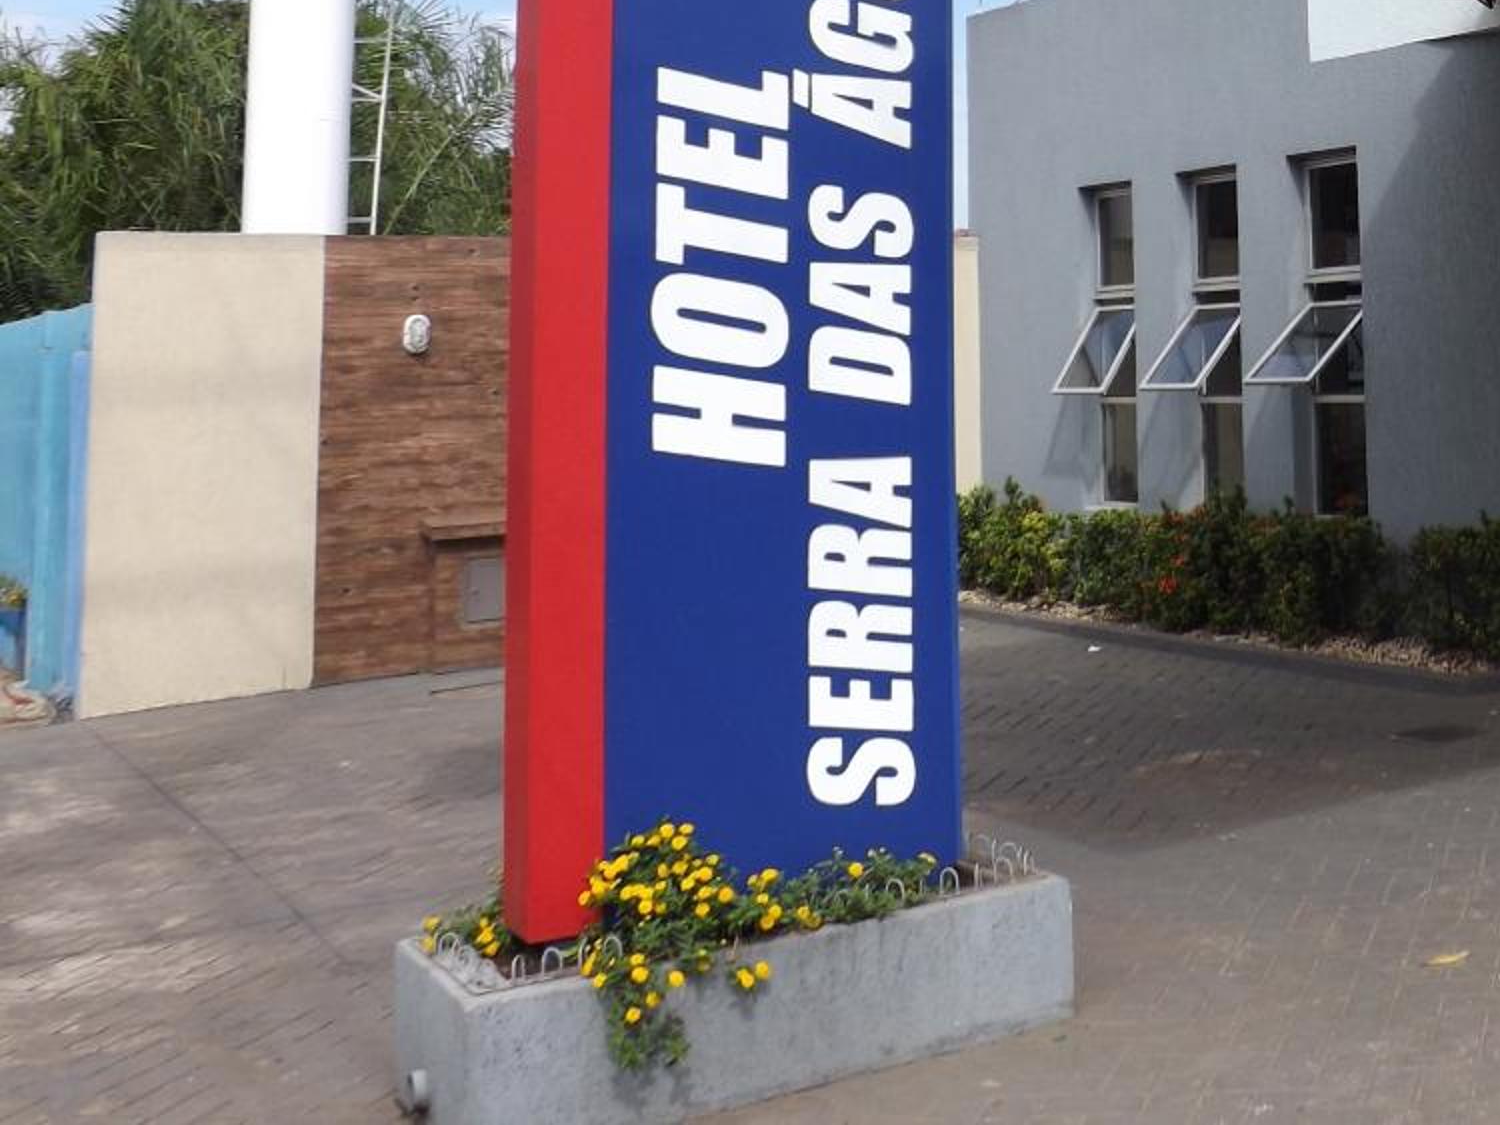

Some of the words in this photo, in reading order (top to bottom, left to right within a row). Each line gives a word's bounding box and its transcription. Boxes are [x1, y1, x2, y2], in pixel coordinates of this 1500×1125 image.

[650, 66, 790, 467] HOTEL
[807, 183, 915, 406] DAS
[806, 455, 917, 806] SERRA
